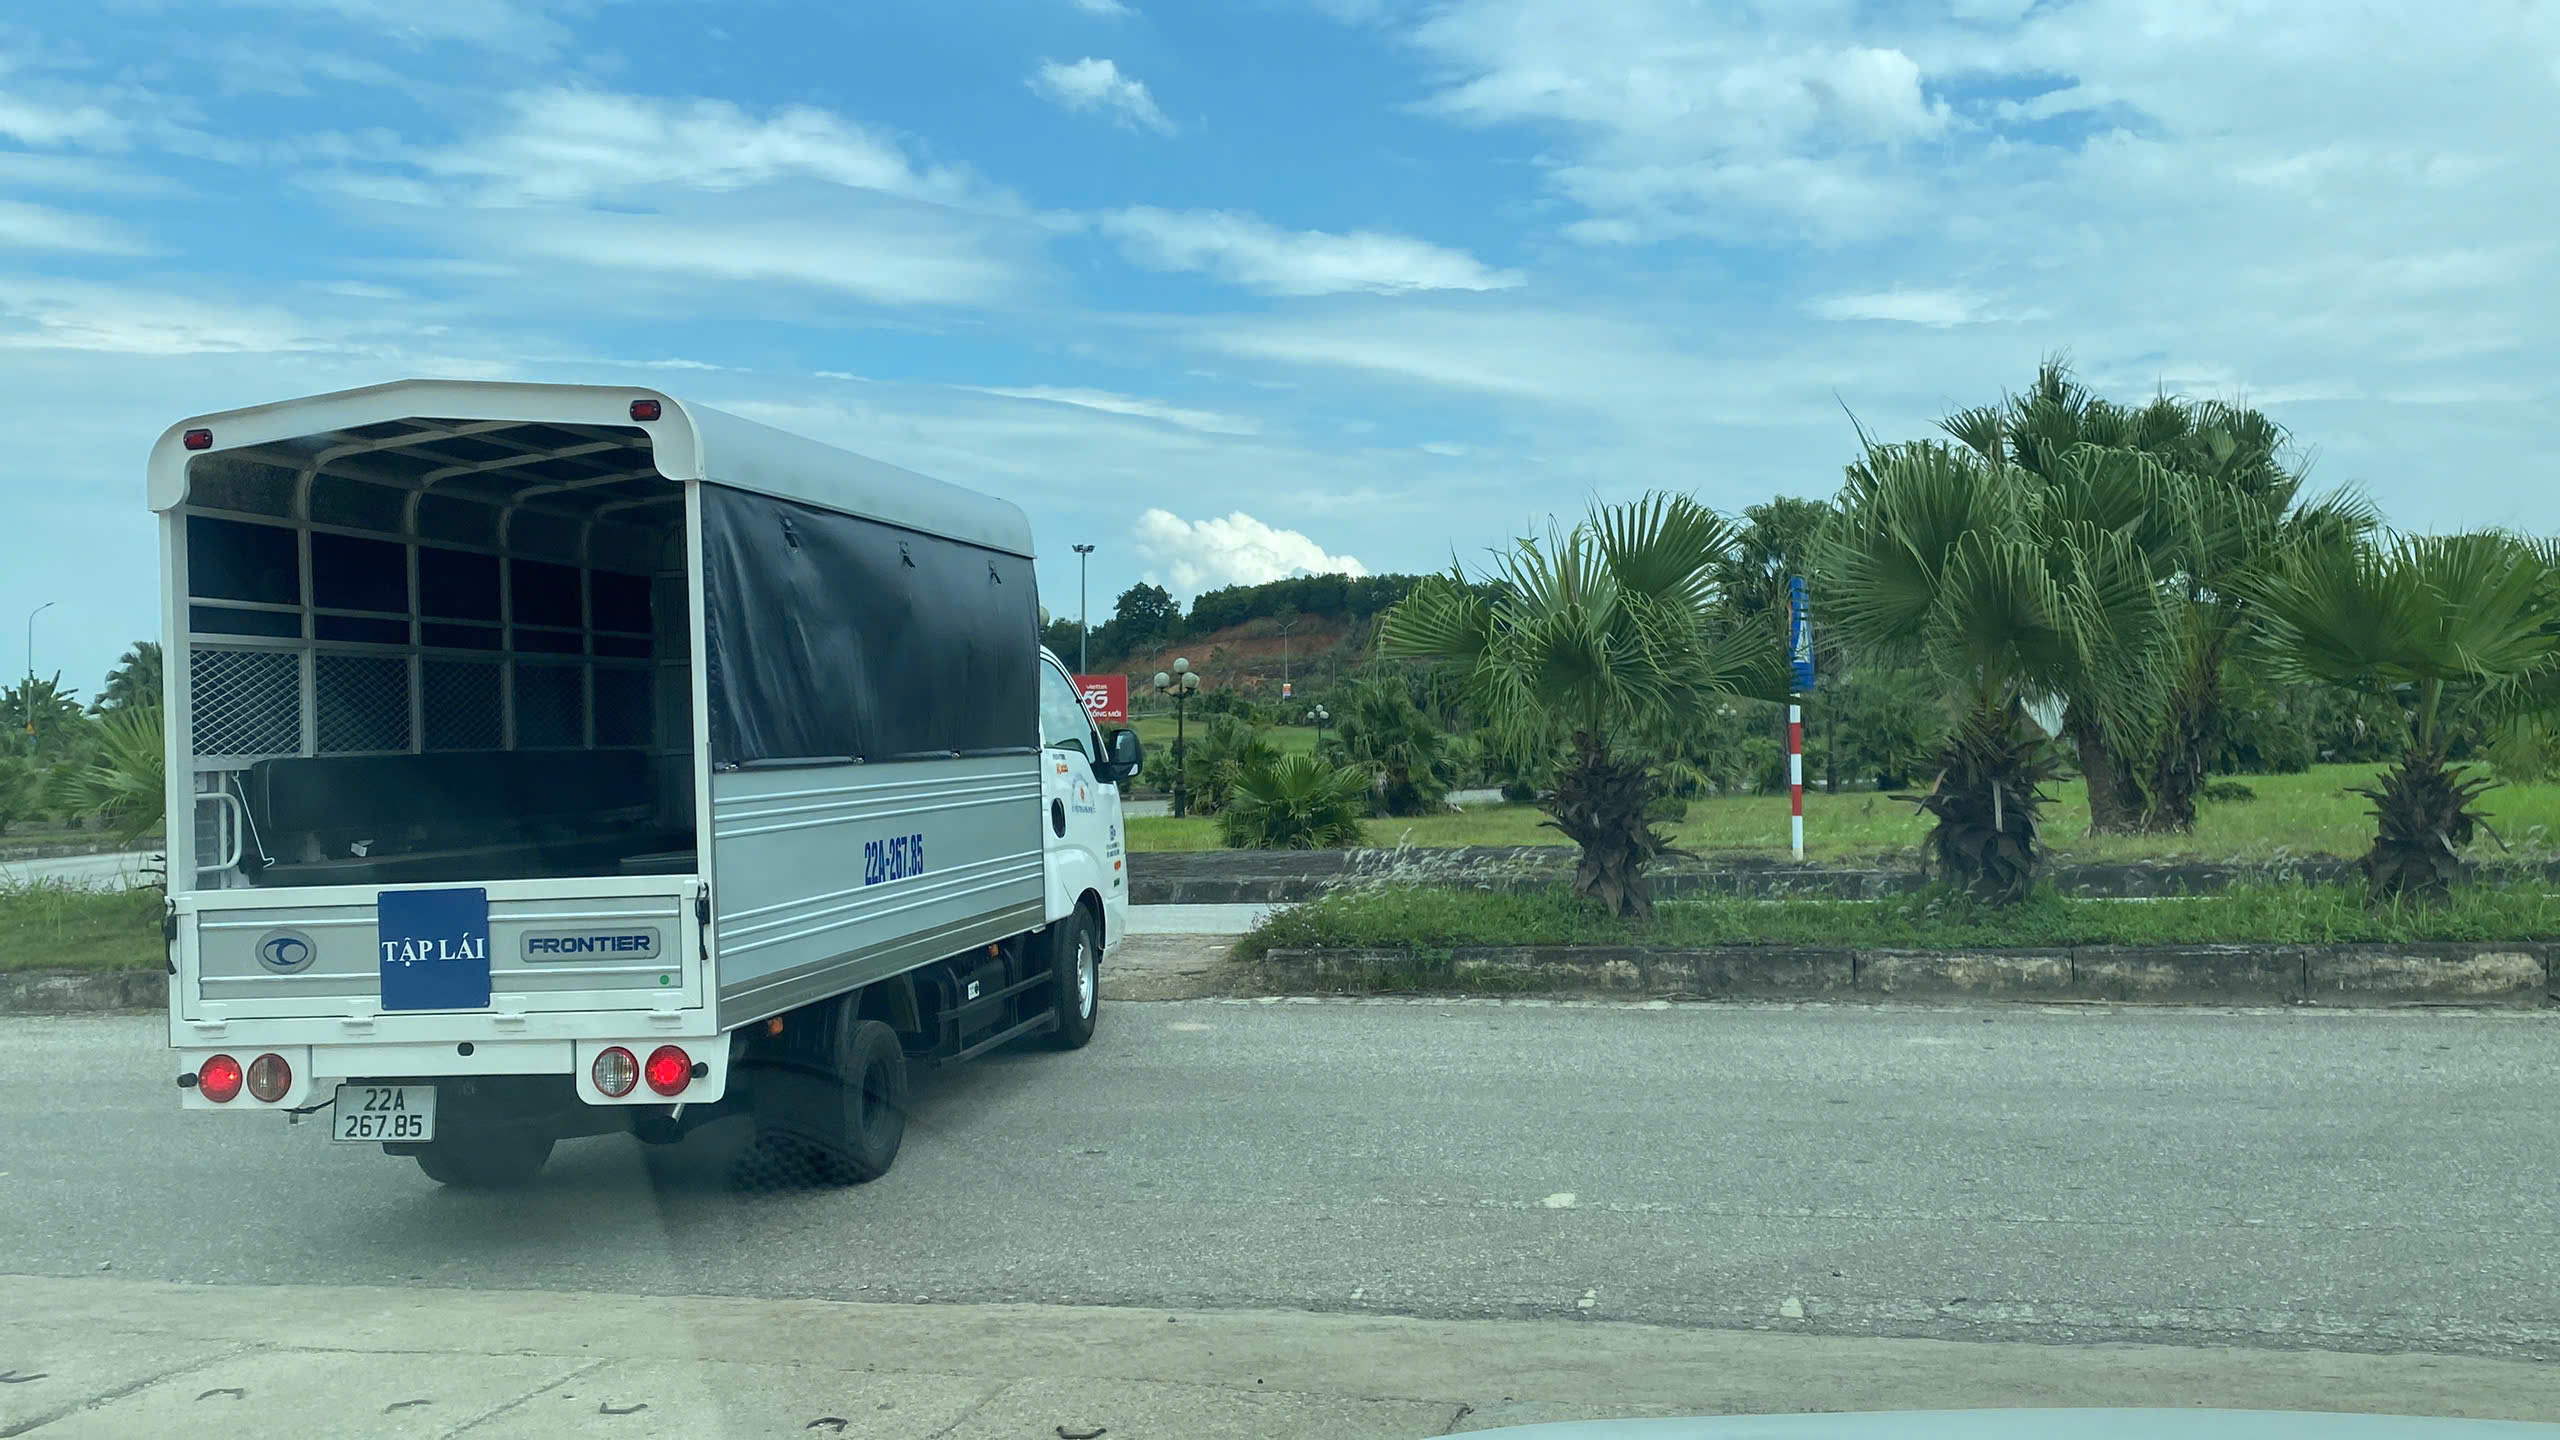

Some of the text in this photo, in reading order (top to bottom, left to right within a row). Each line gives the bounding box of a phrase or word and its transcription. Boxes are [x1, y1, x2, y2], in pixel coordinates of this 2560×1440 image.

[1083, 690, 1108, 709] 5G
[864, 833, 923, 886] 22A-267.85
[381, 932, 486, 967] TẬP LÁI
[528, 935, 651, 954] FRONTIER
[363, 1088, 405, 1111] 22A
[344, 1114, 423, 1138] 267.85
